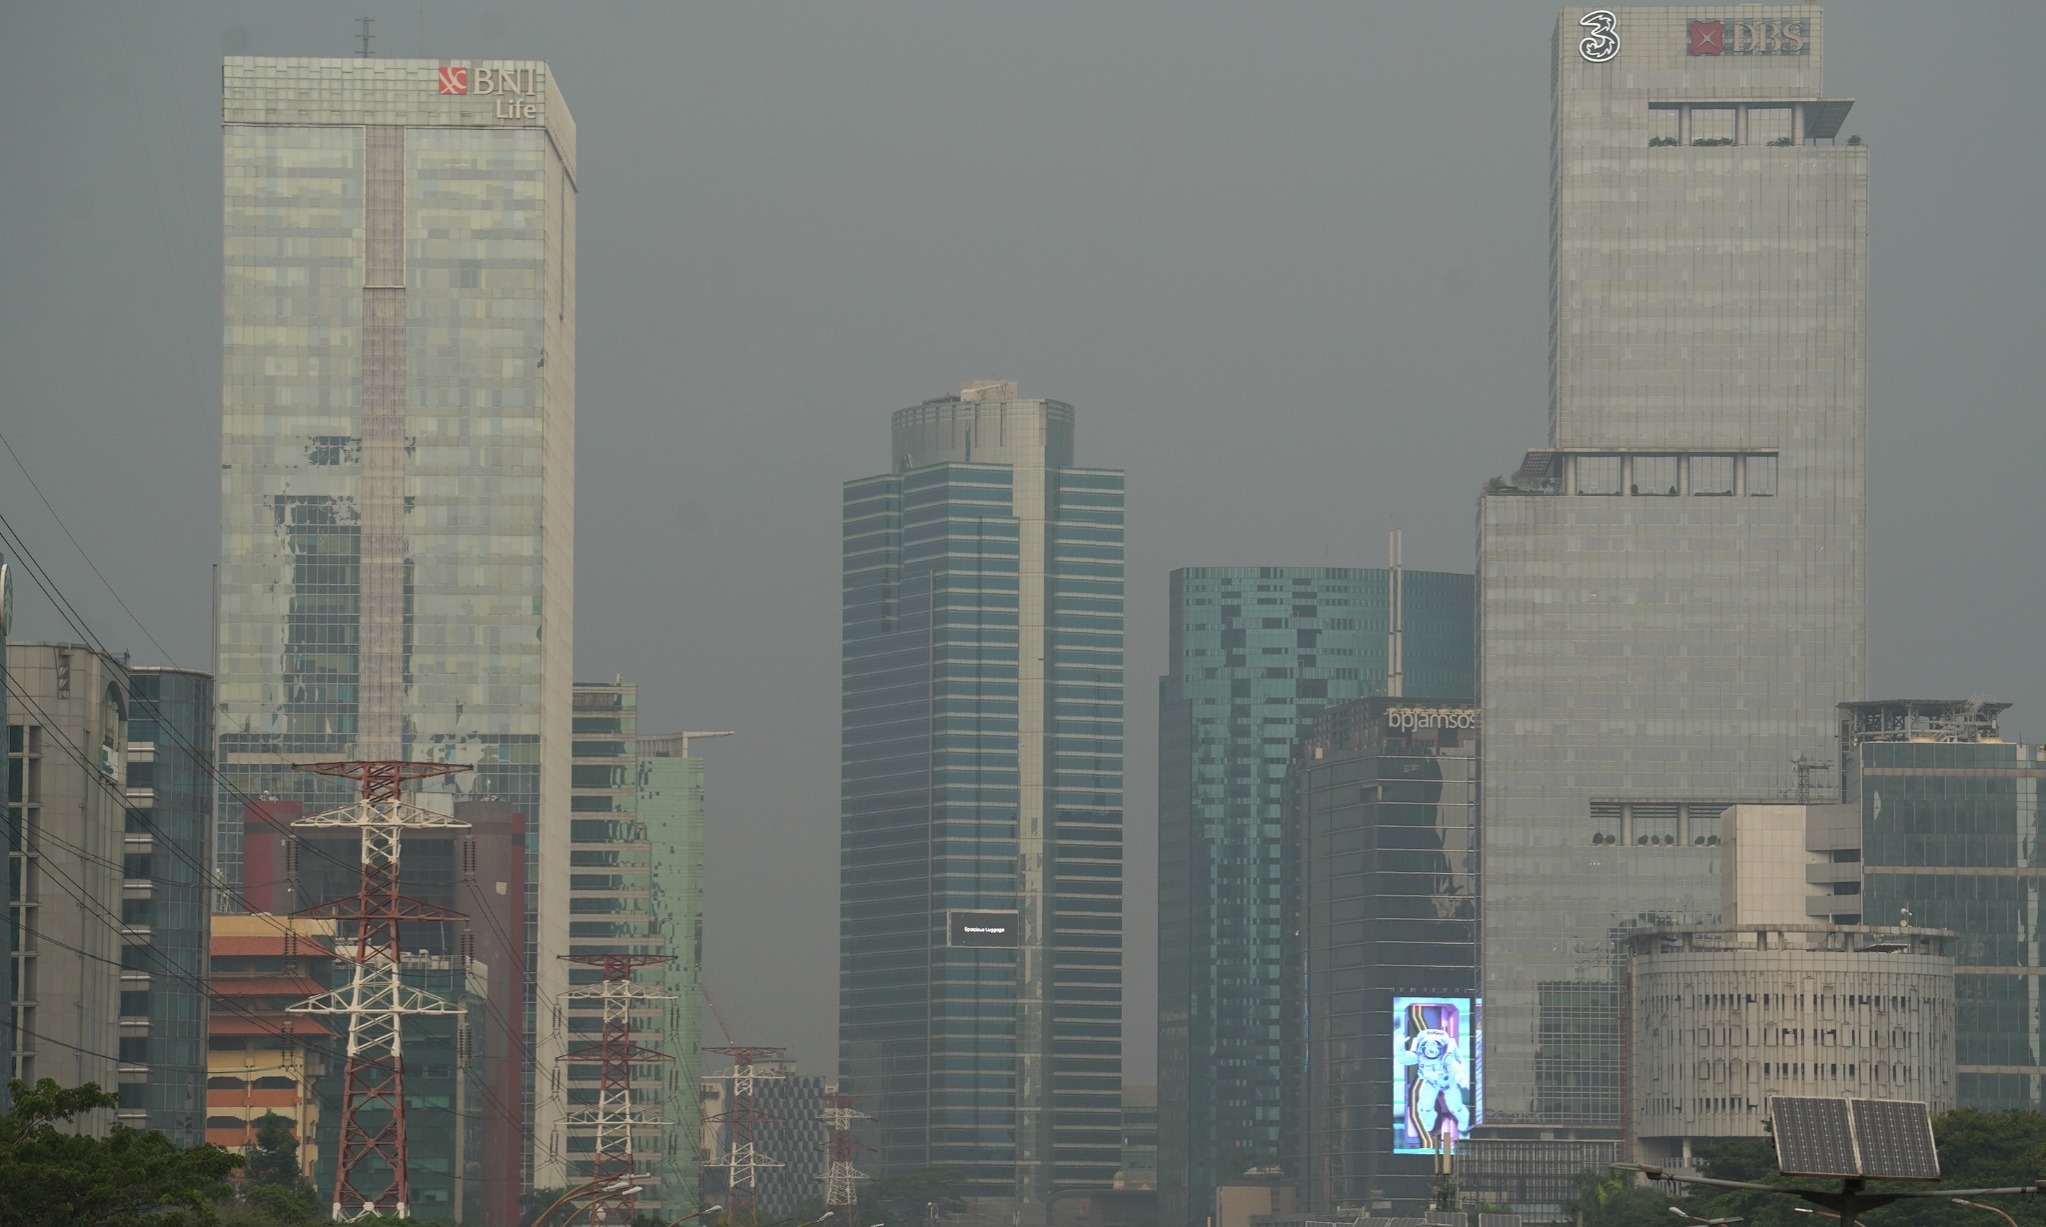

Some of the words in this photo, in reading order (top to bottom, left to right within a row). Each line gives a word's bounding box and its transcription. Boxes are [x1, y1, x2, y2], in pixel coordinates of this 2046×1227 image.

[1579, 10, 1620, 62] 3
[1733, 23, 1803, 52] DBS
[473, 67, 536, 96] BNI
[496, 99, 537, 119] Life
